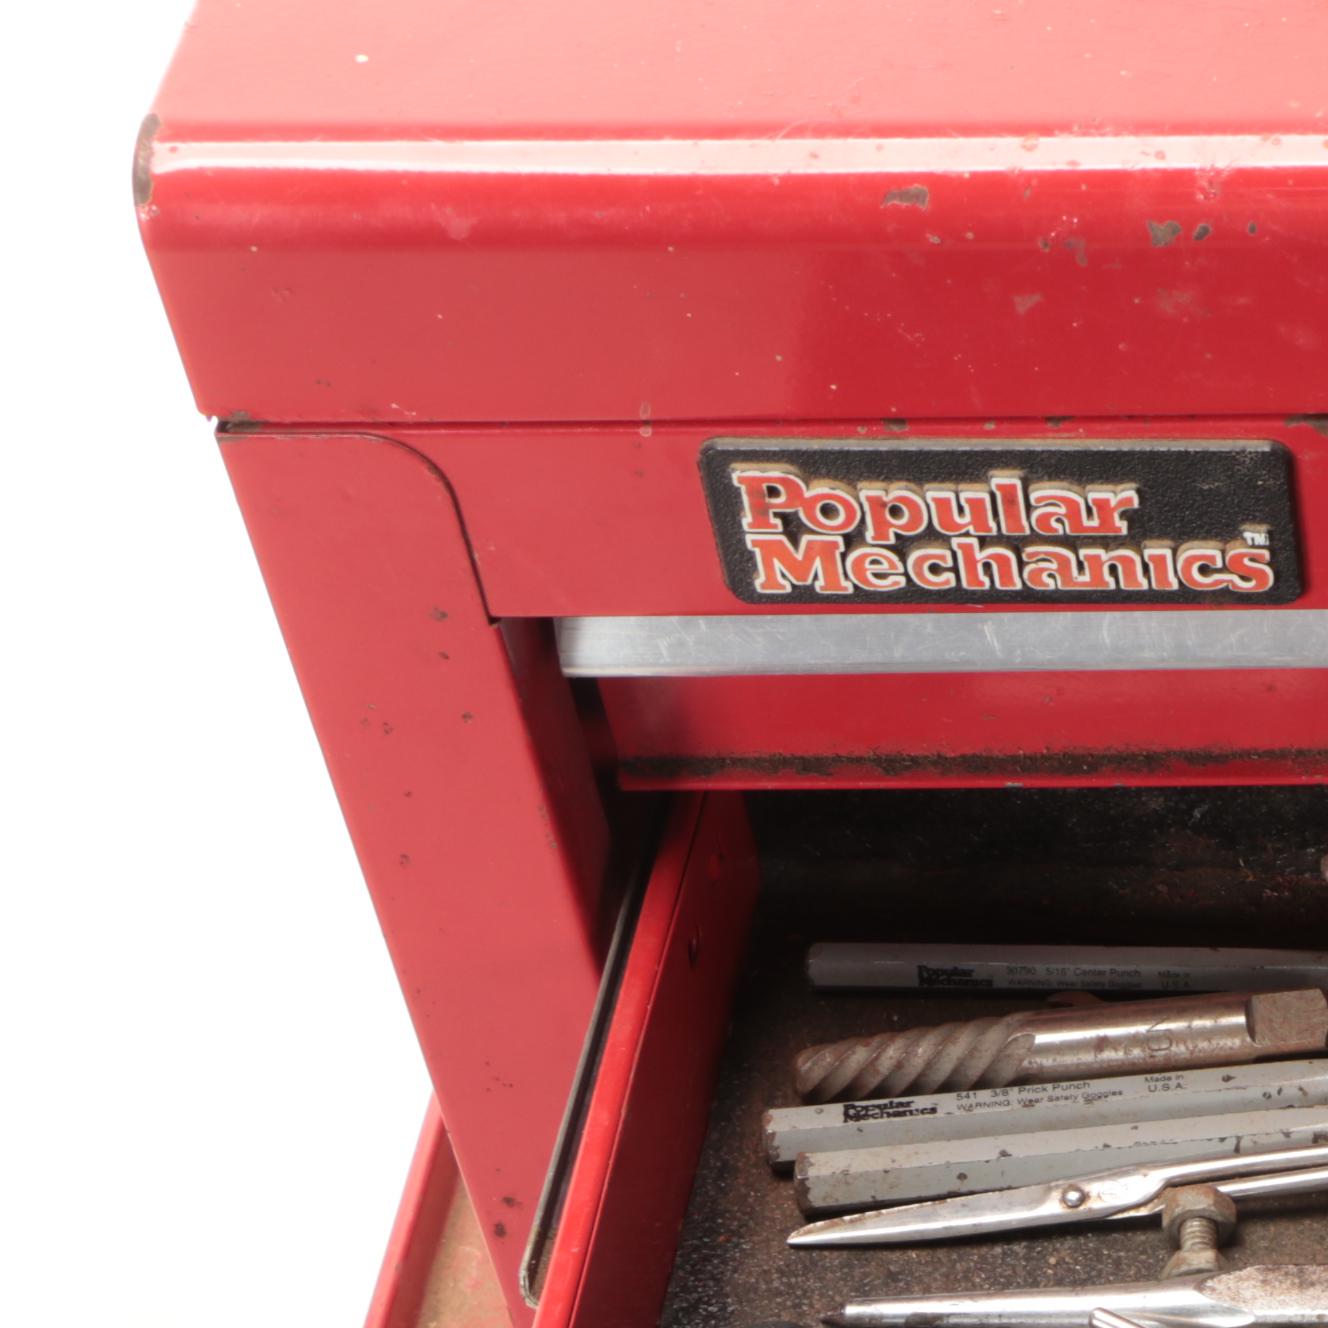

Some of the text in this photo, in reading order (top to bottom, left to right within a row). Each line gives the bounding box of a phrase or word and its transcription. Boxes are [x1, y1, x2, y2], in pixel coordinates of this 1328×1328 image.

[734, 471, 1137, 542] Popular
[748, 534, 1274, 594] Mechanics
[1073, 966, 1107, 977] Center
[1109, 967, 1142, 978] Punch
[1144, 1072, 1184, 1084] Made in
[956, 1091, 977, 1101] 541
[1018, 1083, 1048, 1095] Prick
[1052, 1080, 1090, 1092] Punch
[1017, 1095, 1040, 1105] Wear
[1047, 1092, 1078, 1104] Safety
[1081, 1089, 1123, 1102] Goggles
[843, 1100, 914, 1113] Popular
[843, 1106, 938, 1123] Mechanics
